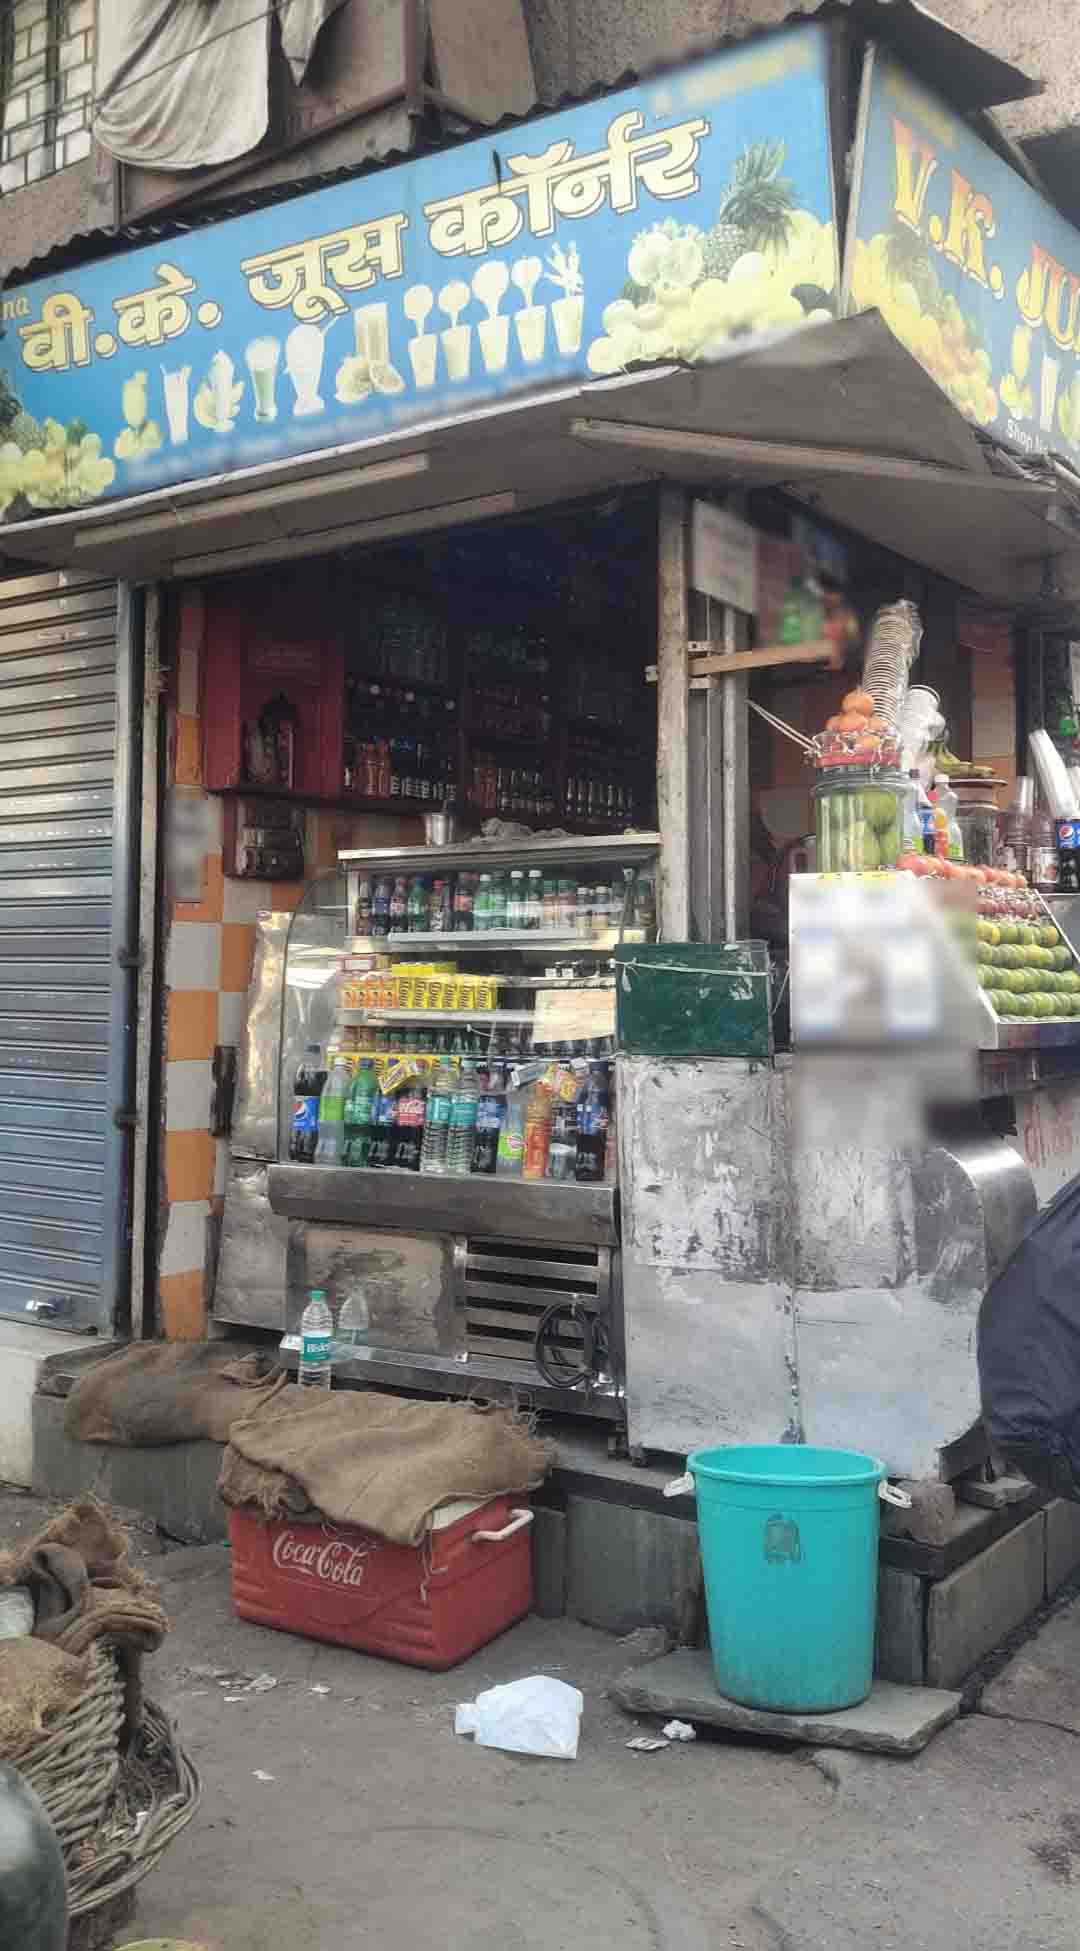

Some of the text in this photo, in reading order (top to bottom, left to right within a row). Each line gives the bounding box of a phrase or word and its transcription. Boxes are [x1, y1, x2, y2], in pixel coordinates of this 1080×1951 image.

[240, 212, 410, 323] जूस
[423, 110, 712, 257] कॉर्नर
[893, 116, 1080, 360] V.K. JU
[272, 1530, 369, 1587] Coca-Cola
